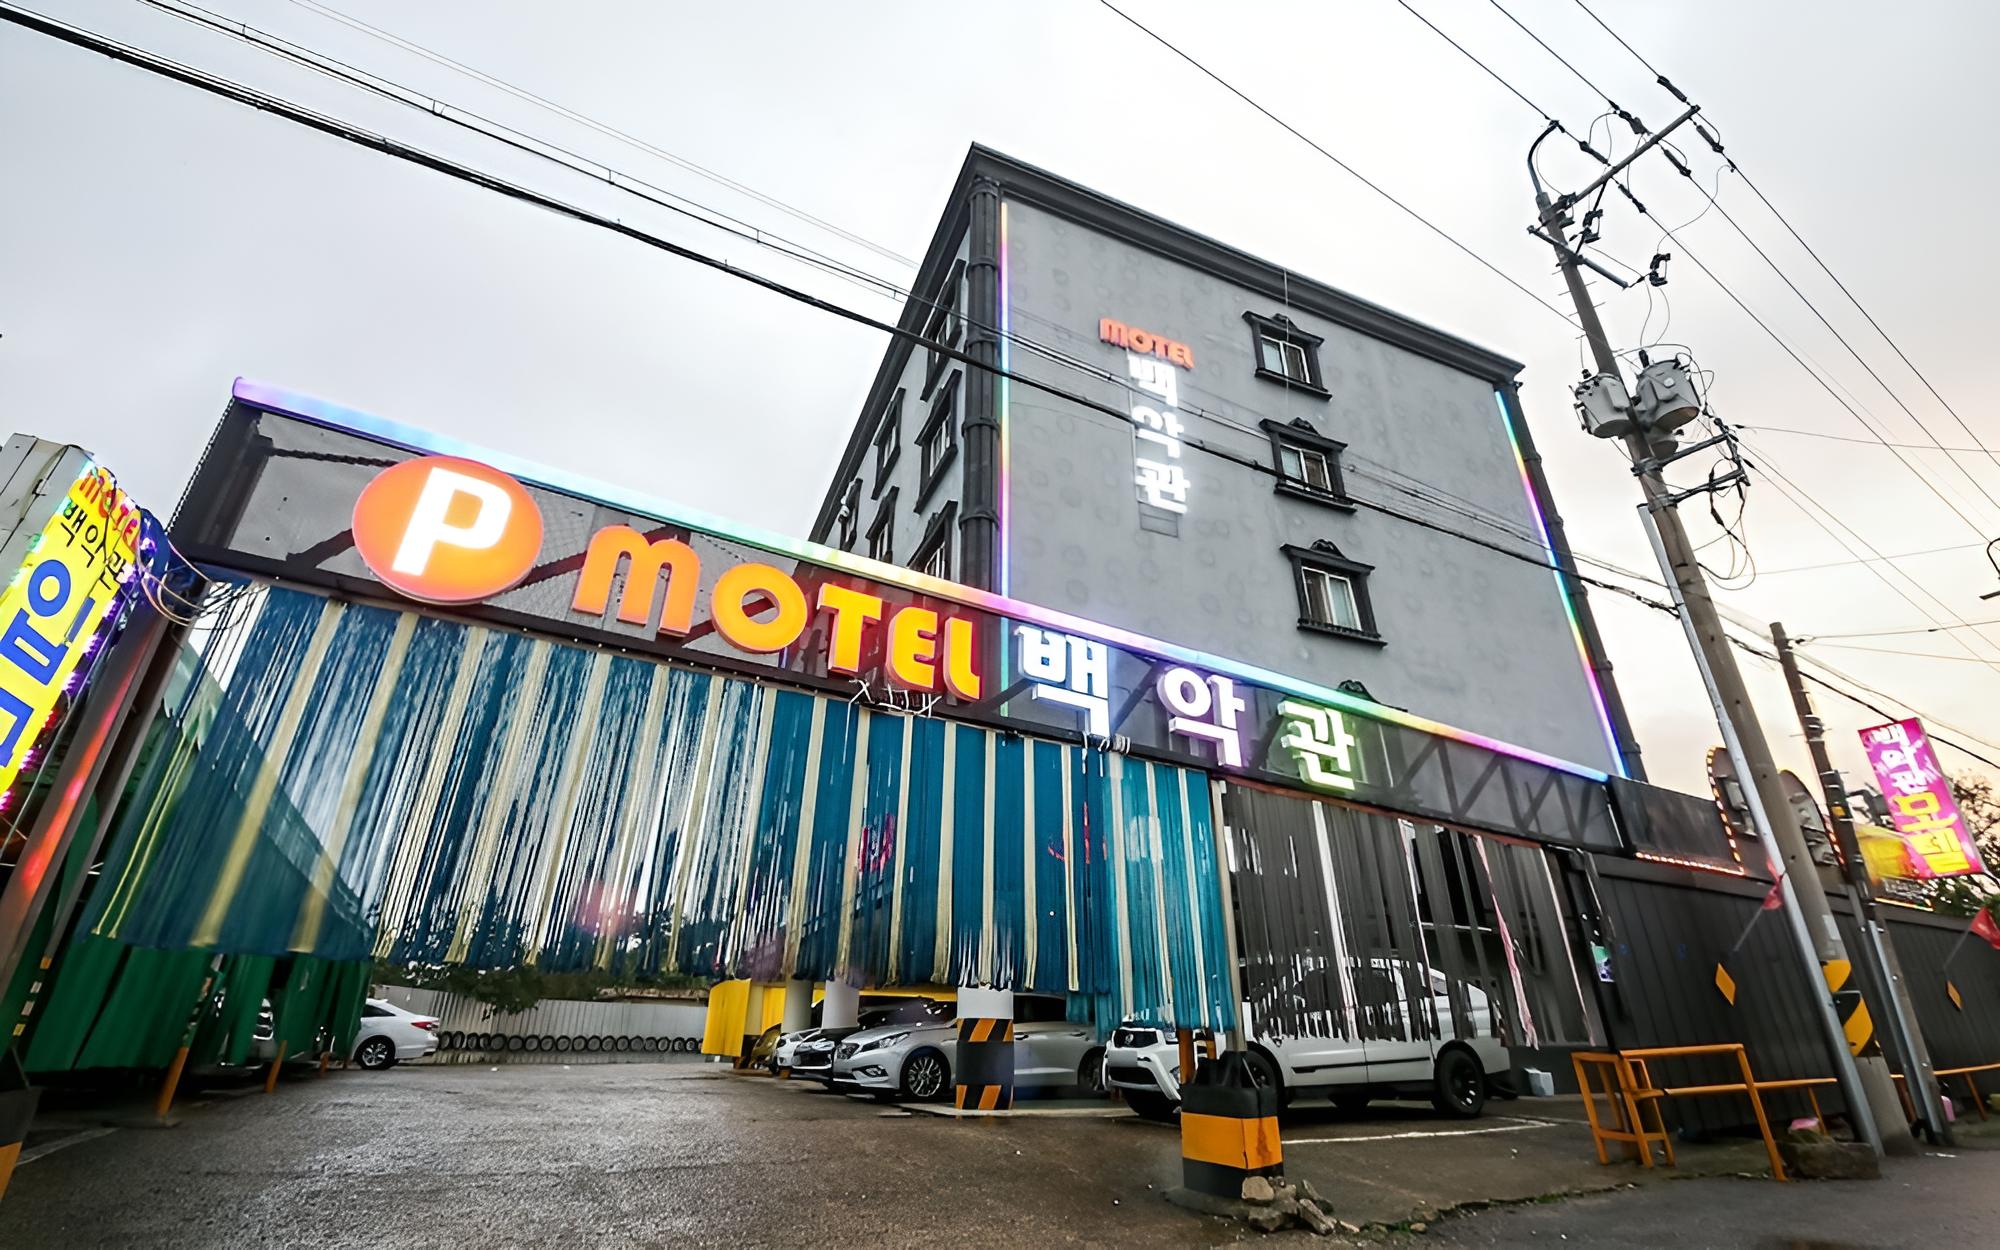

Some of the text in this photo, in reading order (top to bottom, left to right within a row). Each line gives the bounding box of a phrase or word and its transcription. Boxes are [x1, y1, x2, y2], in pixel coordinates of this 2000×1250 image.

[1098, 318, 1195, 371] MOTEL
[1128, 354, 1191, 514] 백악관
[392, 466, 512, 577] P
[571, 524, 1356, 791] MOTEL 백악관
[1894, 791, 1971, 874] 모텔
